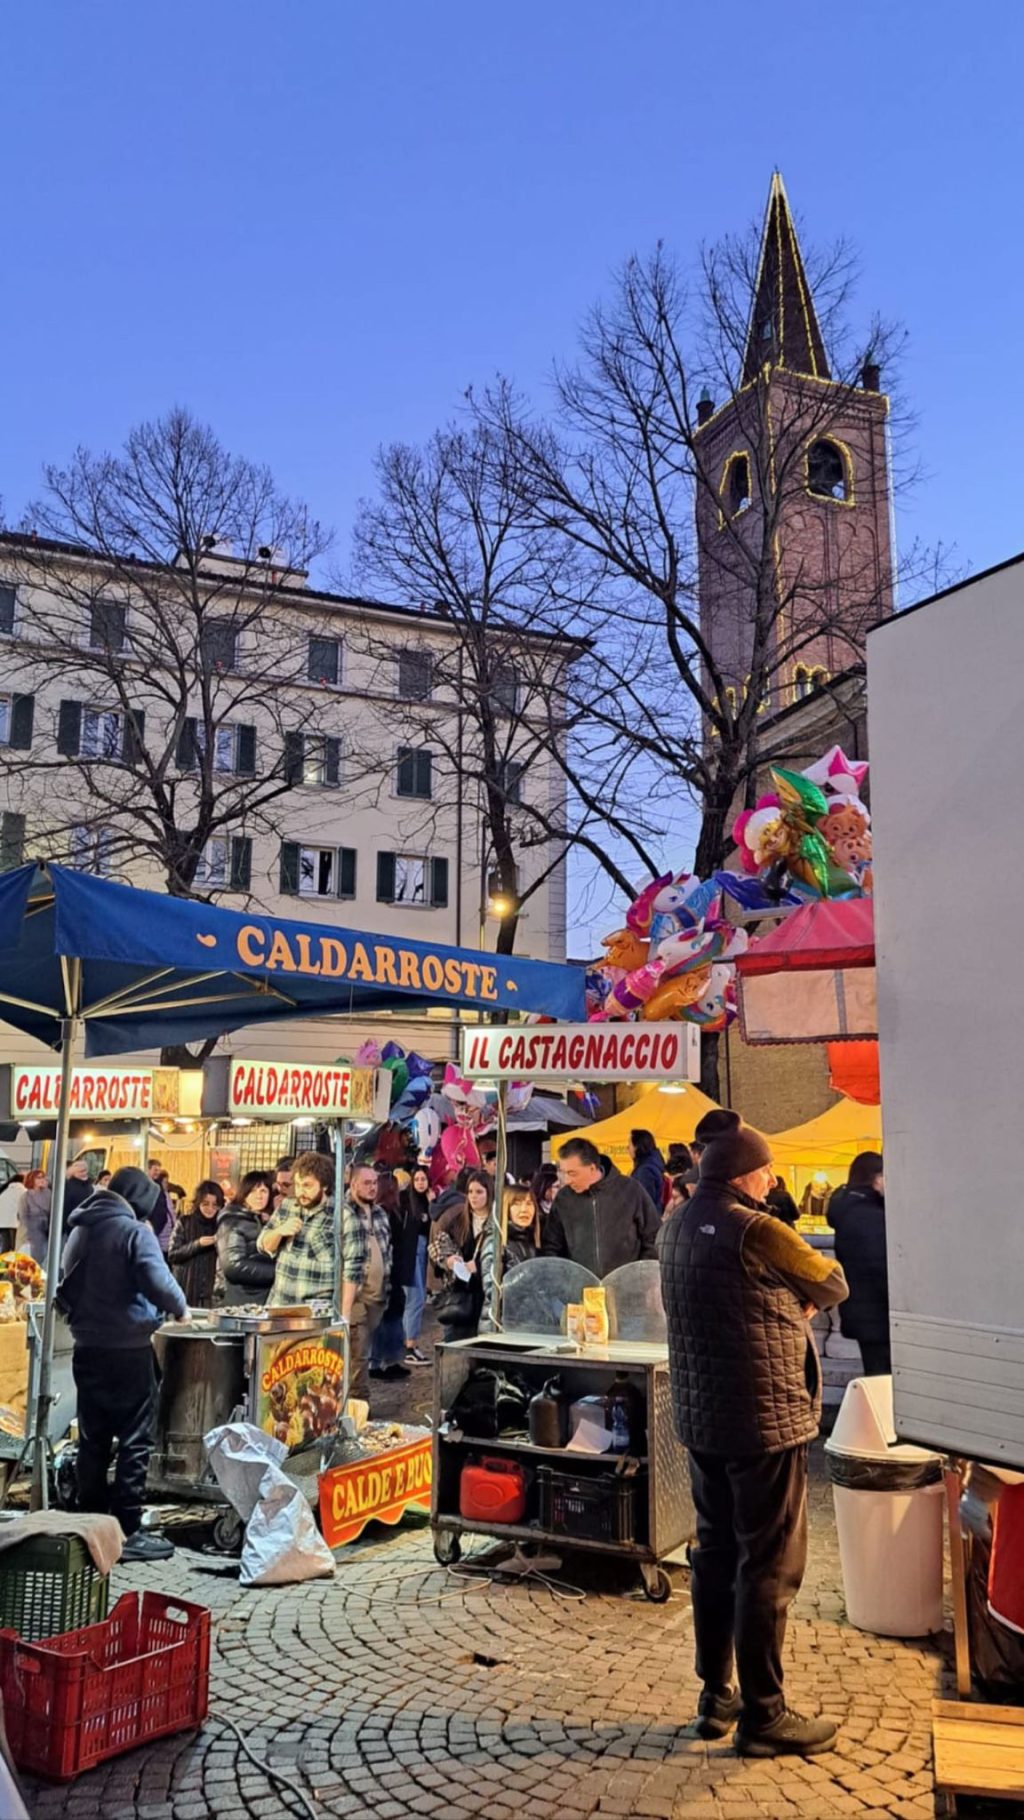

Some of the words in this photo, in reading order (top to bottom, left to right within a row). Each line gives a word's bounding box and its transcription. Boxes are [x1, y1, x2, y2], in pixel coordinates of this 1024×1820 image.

[237, 925, 498, 1000] CALDARROSTE
[469, 1036, 489, 1069] IL
[498, 1033, 678, 1070] CASTAGNACCIO
[232, 1066, 350, 1108] CALDARROSTE
[262, 1348, 344, 1392] CALDARROSTE
[332, 1467, 392, 1521] CALDE
[394, 1462, 406, 1498] E
